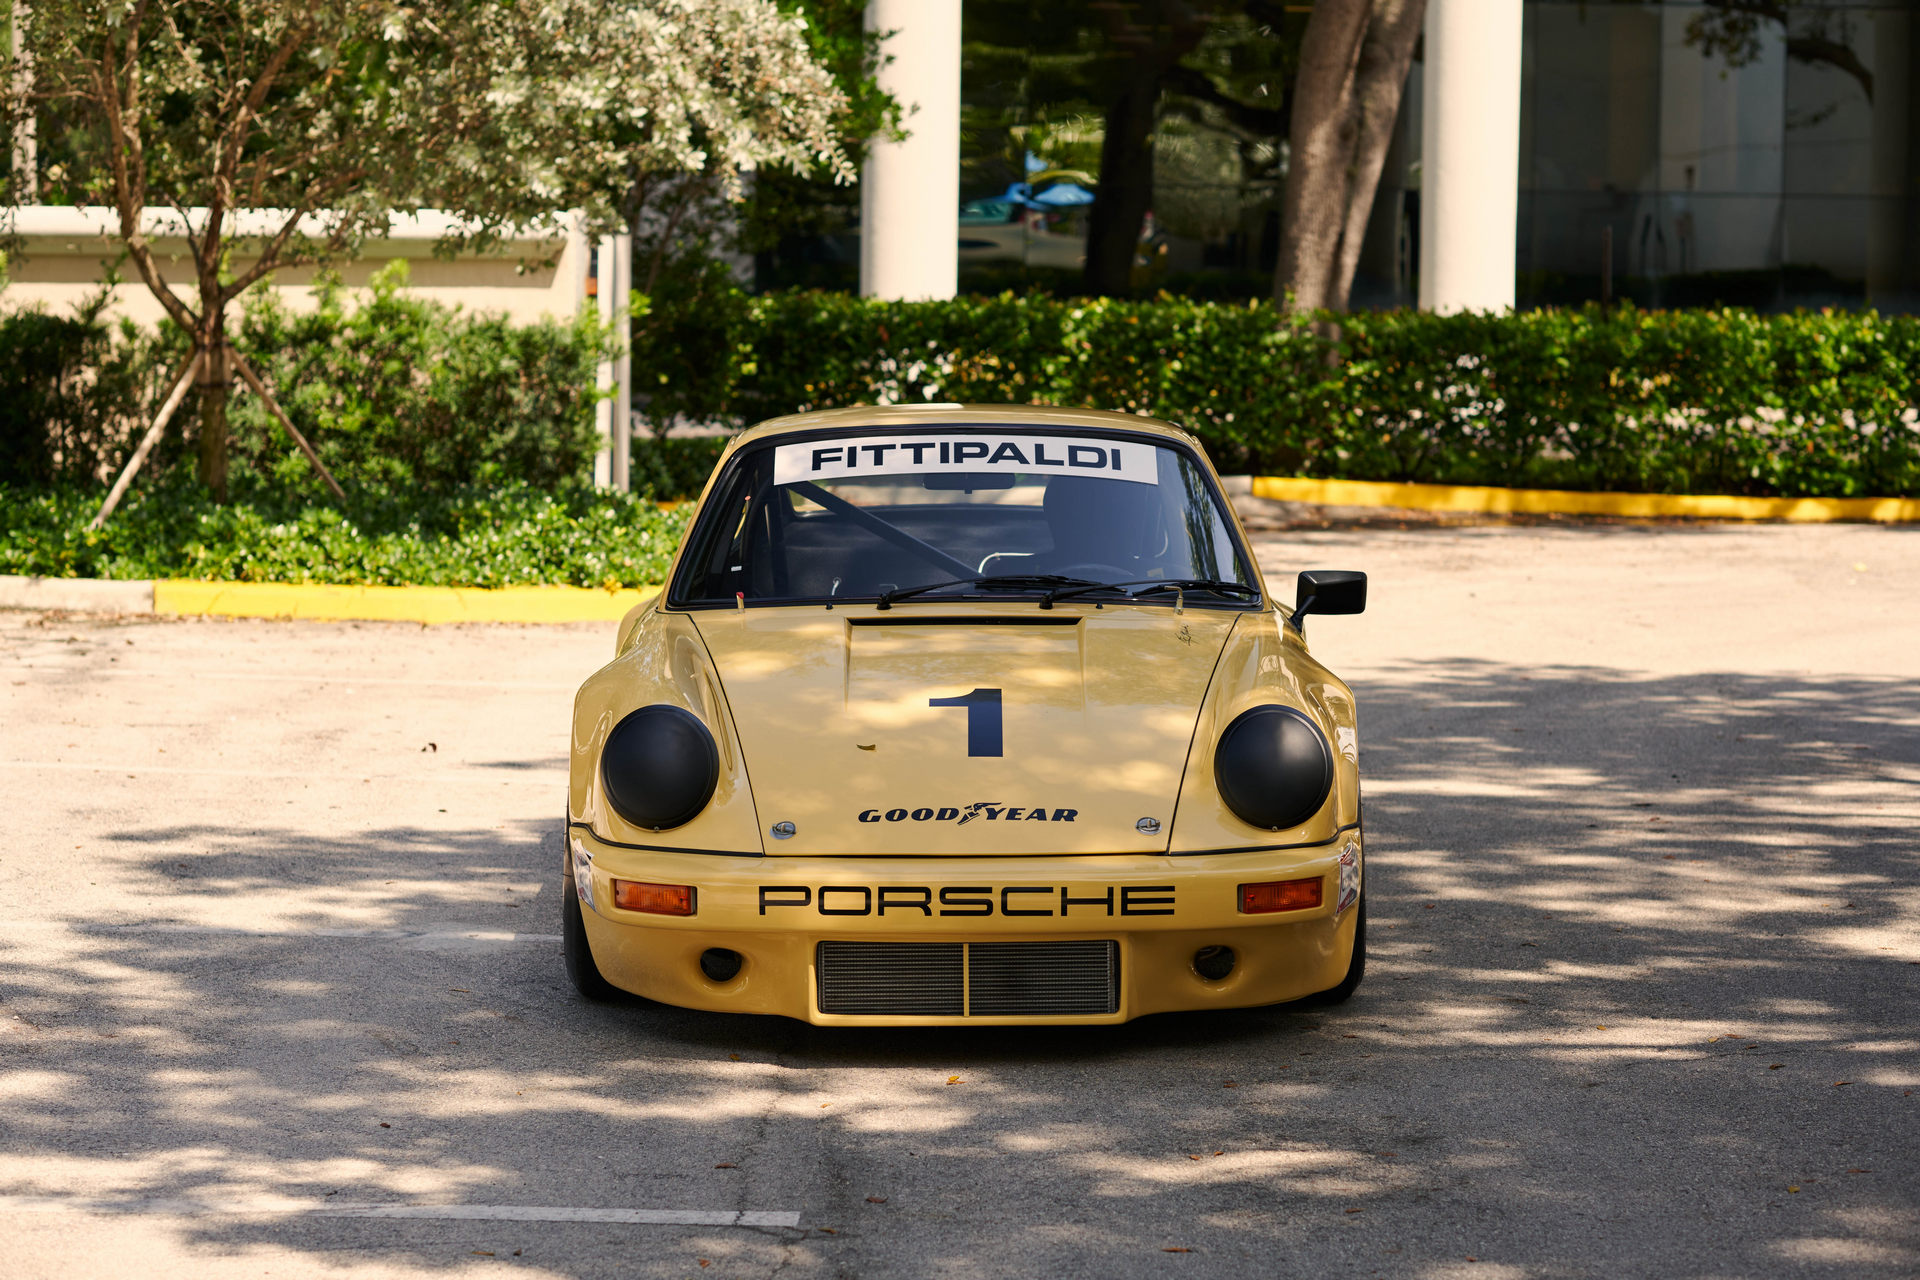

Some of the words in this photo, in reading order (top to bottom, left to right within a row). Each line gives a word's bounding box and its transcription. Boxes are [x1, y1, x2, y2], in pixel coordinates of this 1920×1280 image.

[811, 441, 1122, 470] FITTIPALDI
[928, 688, 1004, 758] 1
[758, 885, 1176, 917] PORSCHE
